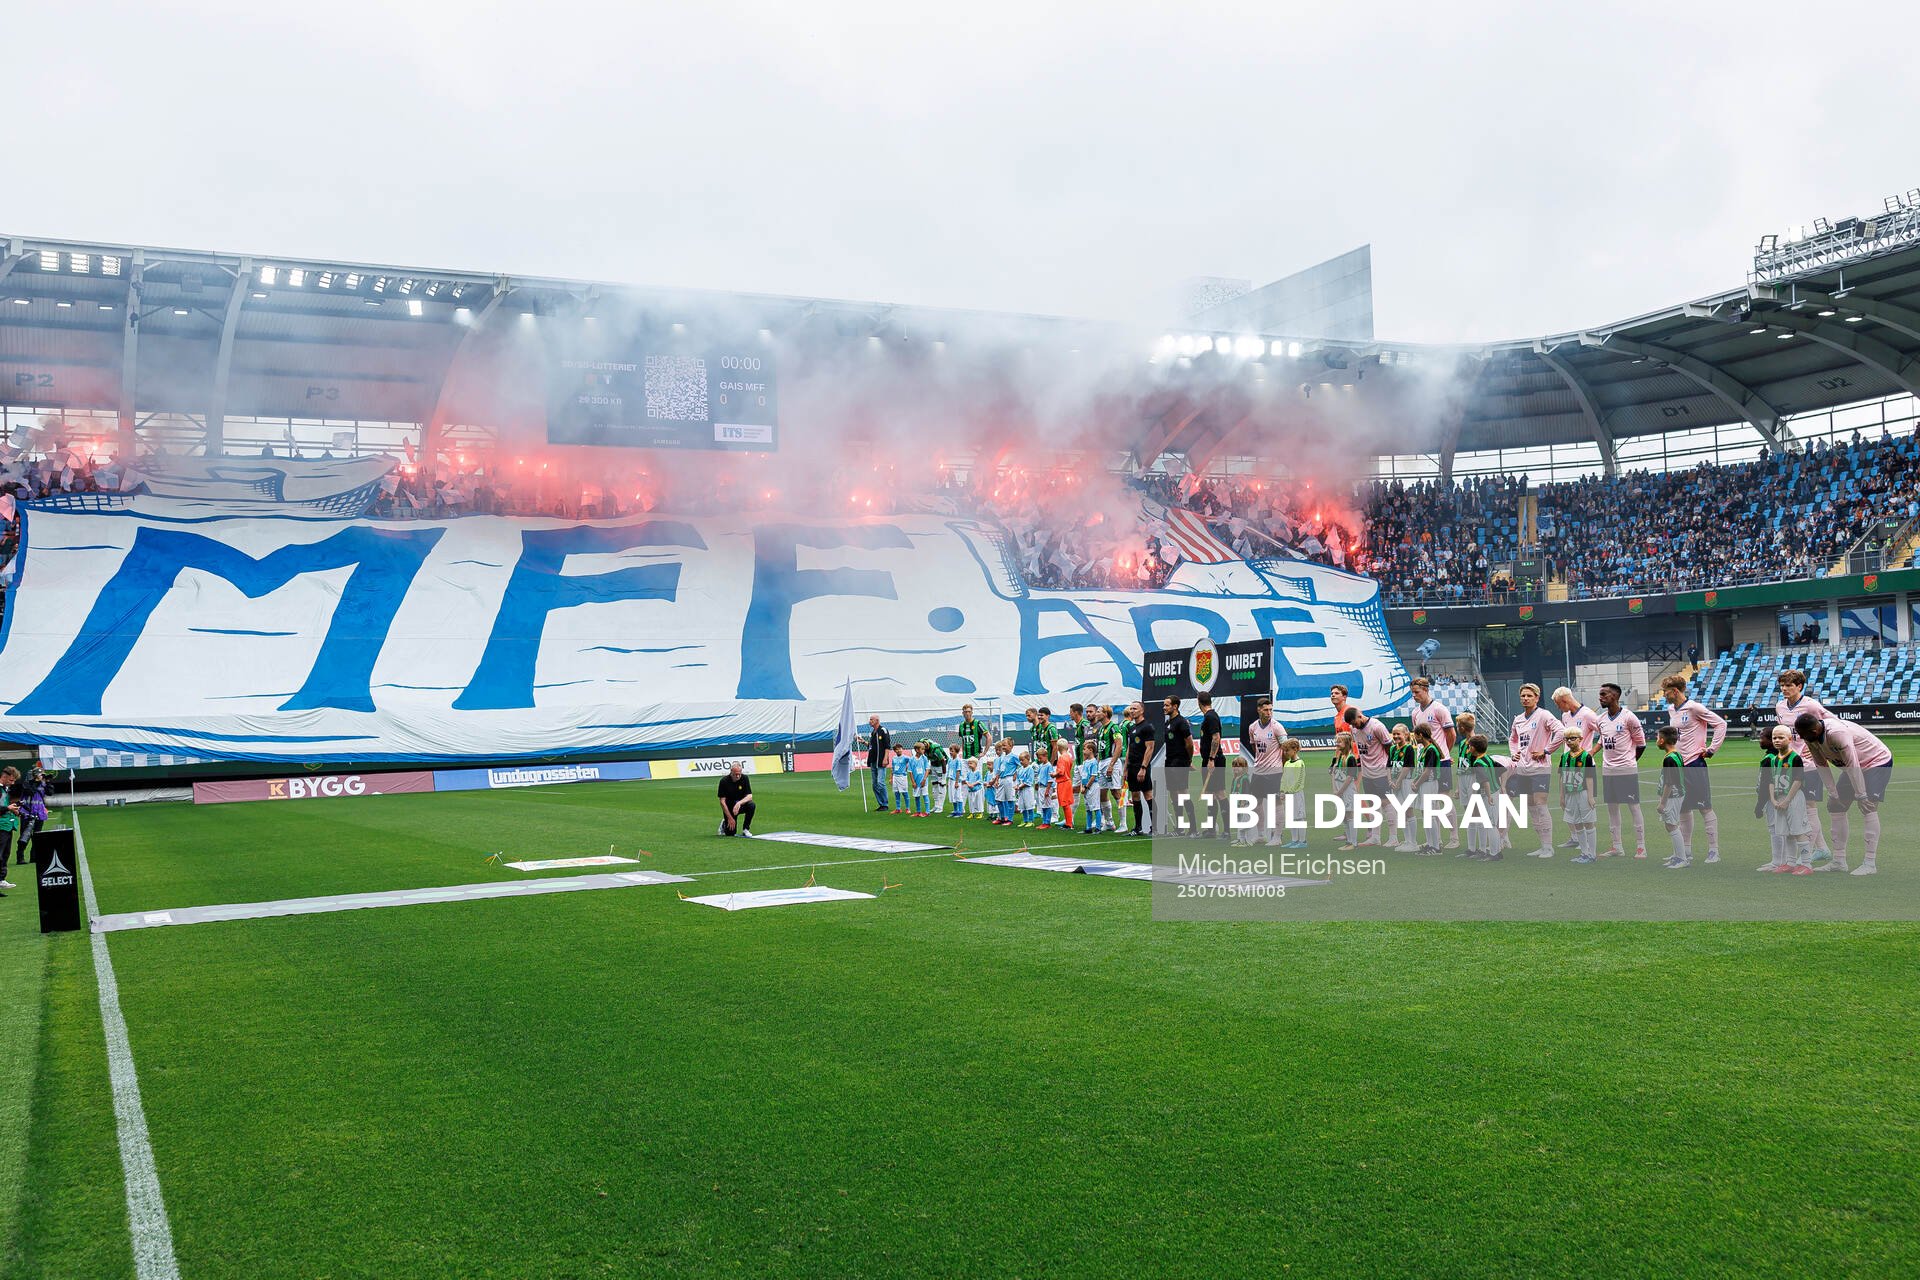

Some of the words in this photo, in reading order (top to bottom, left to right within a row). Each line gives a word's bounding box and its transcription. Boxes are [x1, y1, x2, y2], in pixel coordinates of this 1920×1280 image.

[721, 356, 761, 370] 00:00
[15, 372, 54, 388] P2
[719, 381, 744, 392] GAIS
[745, 383, 766, 393] MFF
[1816, 376, 1852, 391] D2
[305, 385, 341, 401] P3
[720, 394, 728, 405] 0
[758, 395, 767, 407] 0
[722, 426, 743, 438] ITS
[1148, 660, 1184, 677] UNIBET
[1224, 652, 1264, 671] UNIBET
[1840, 711, 1862, 720] Ullevi
[1311, 739, 1326, 747] TILL
[700, 759, 746, 772] webr
[1562, 771, 1584, 786] ITS
[289, 776, 367, 798] BYGG
[41, 876, 73, 887] SELECT
